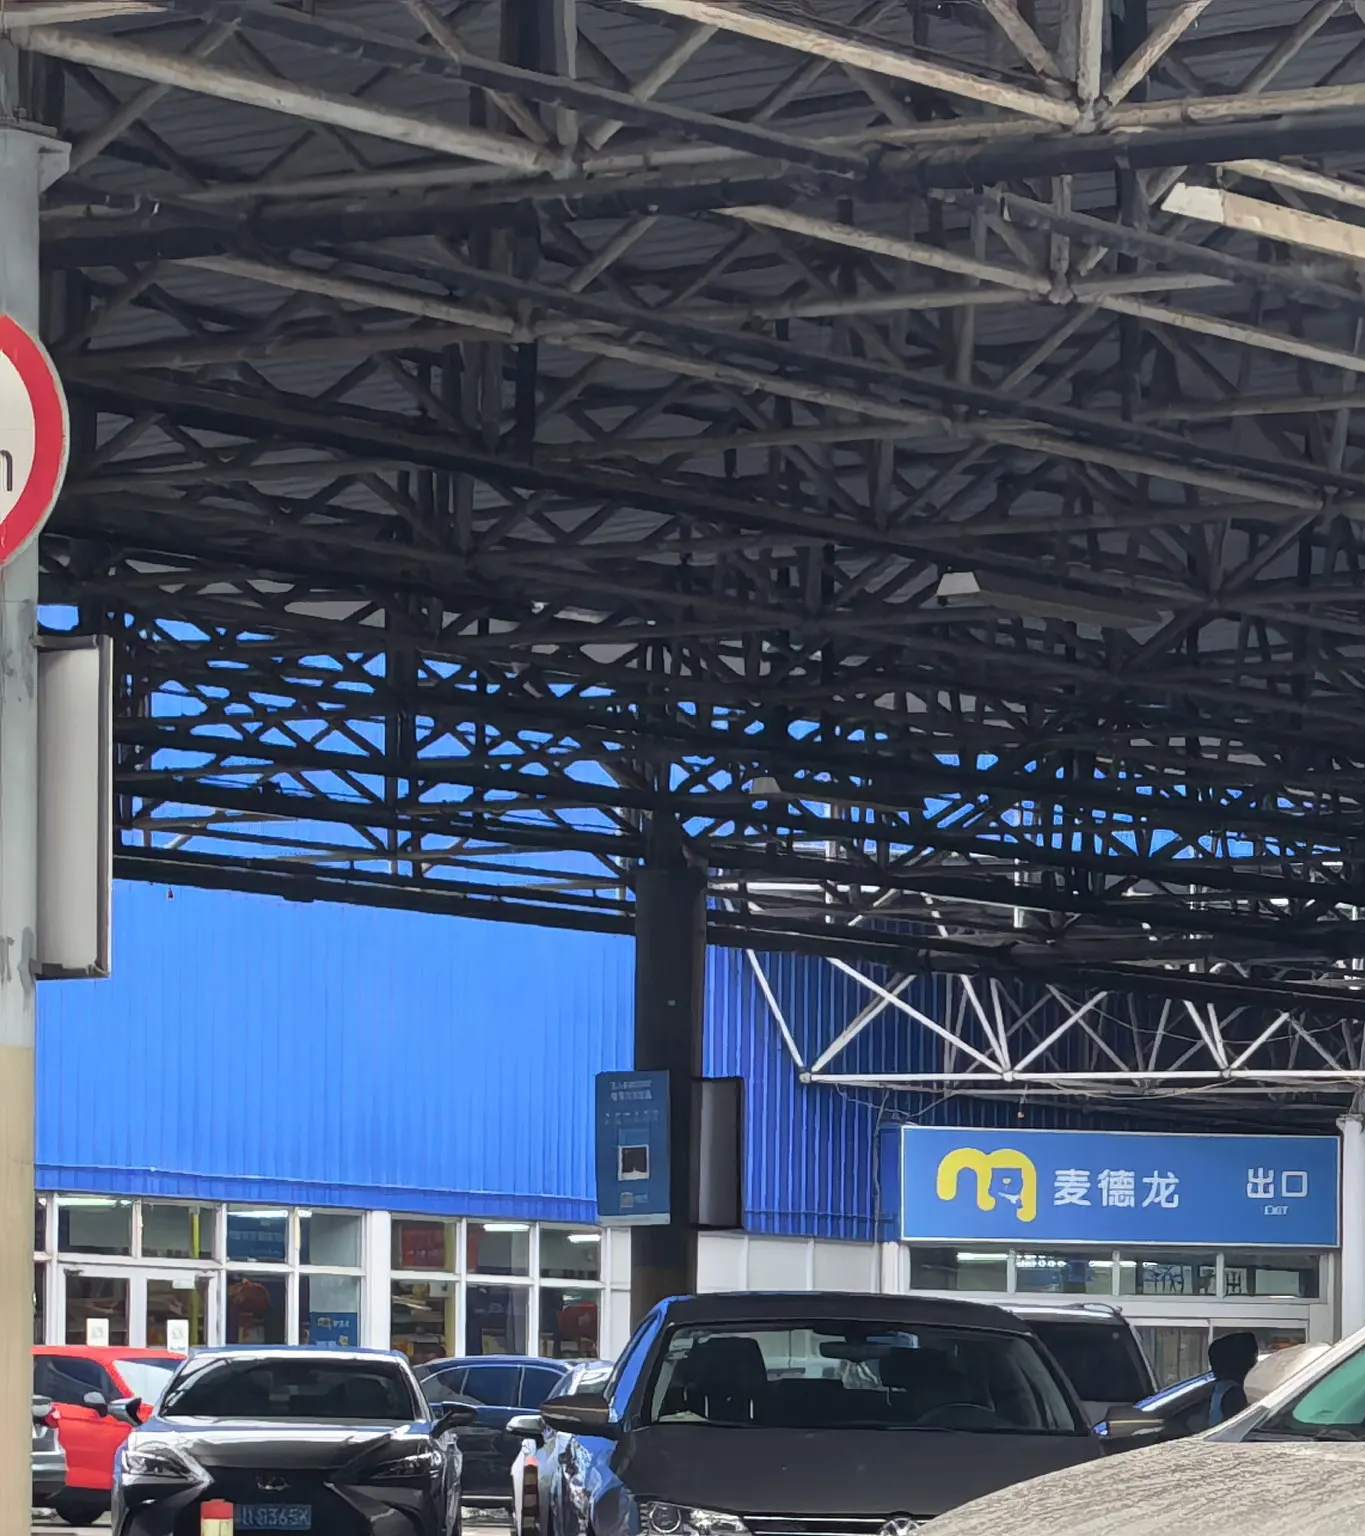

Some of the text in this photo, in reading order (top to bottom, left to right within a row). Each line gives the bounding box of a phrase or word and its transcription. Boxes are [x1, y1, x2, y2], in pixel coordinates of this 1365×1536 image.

[1053, 1168, 1180, 1208] 麦德龙
[1246, 1167, 1308, 1199] 出口
